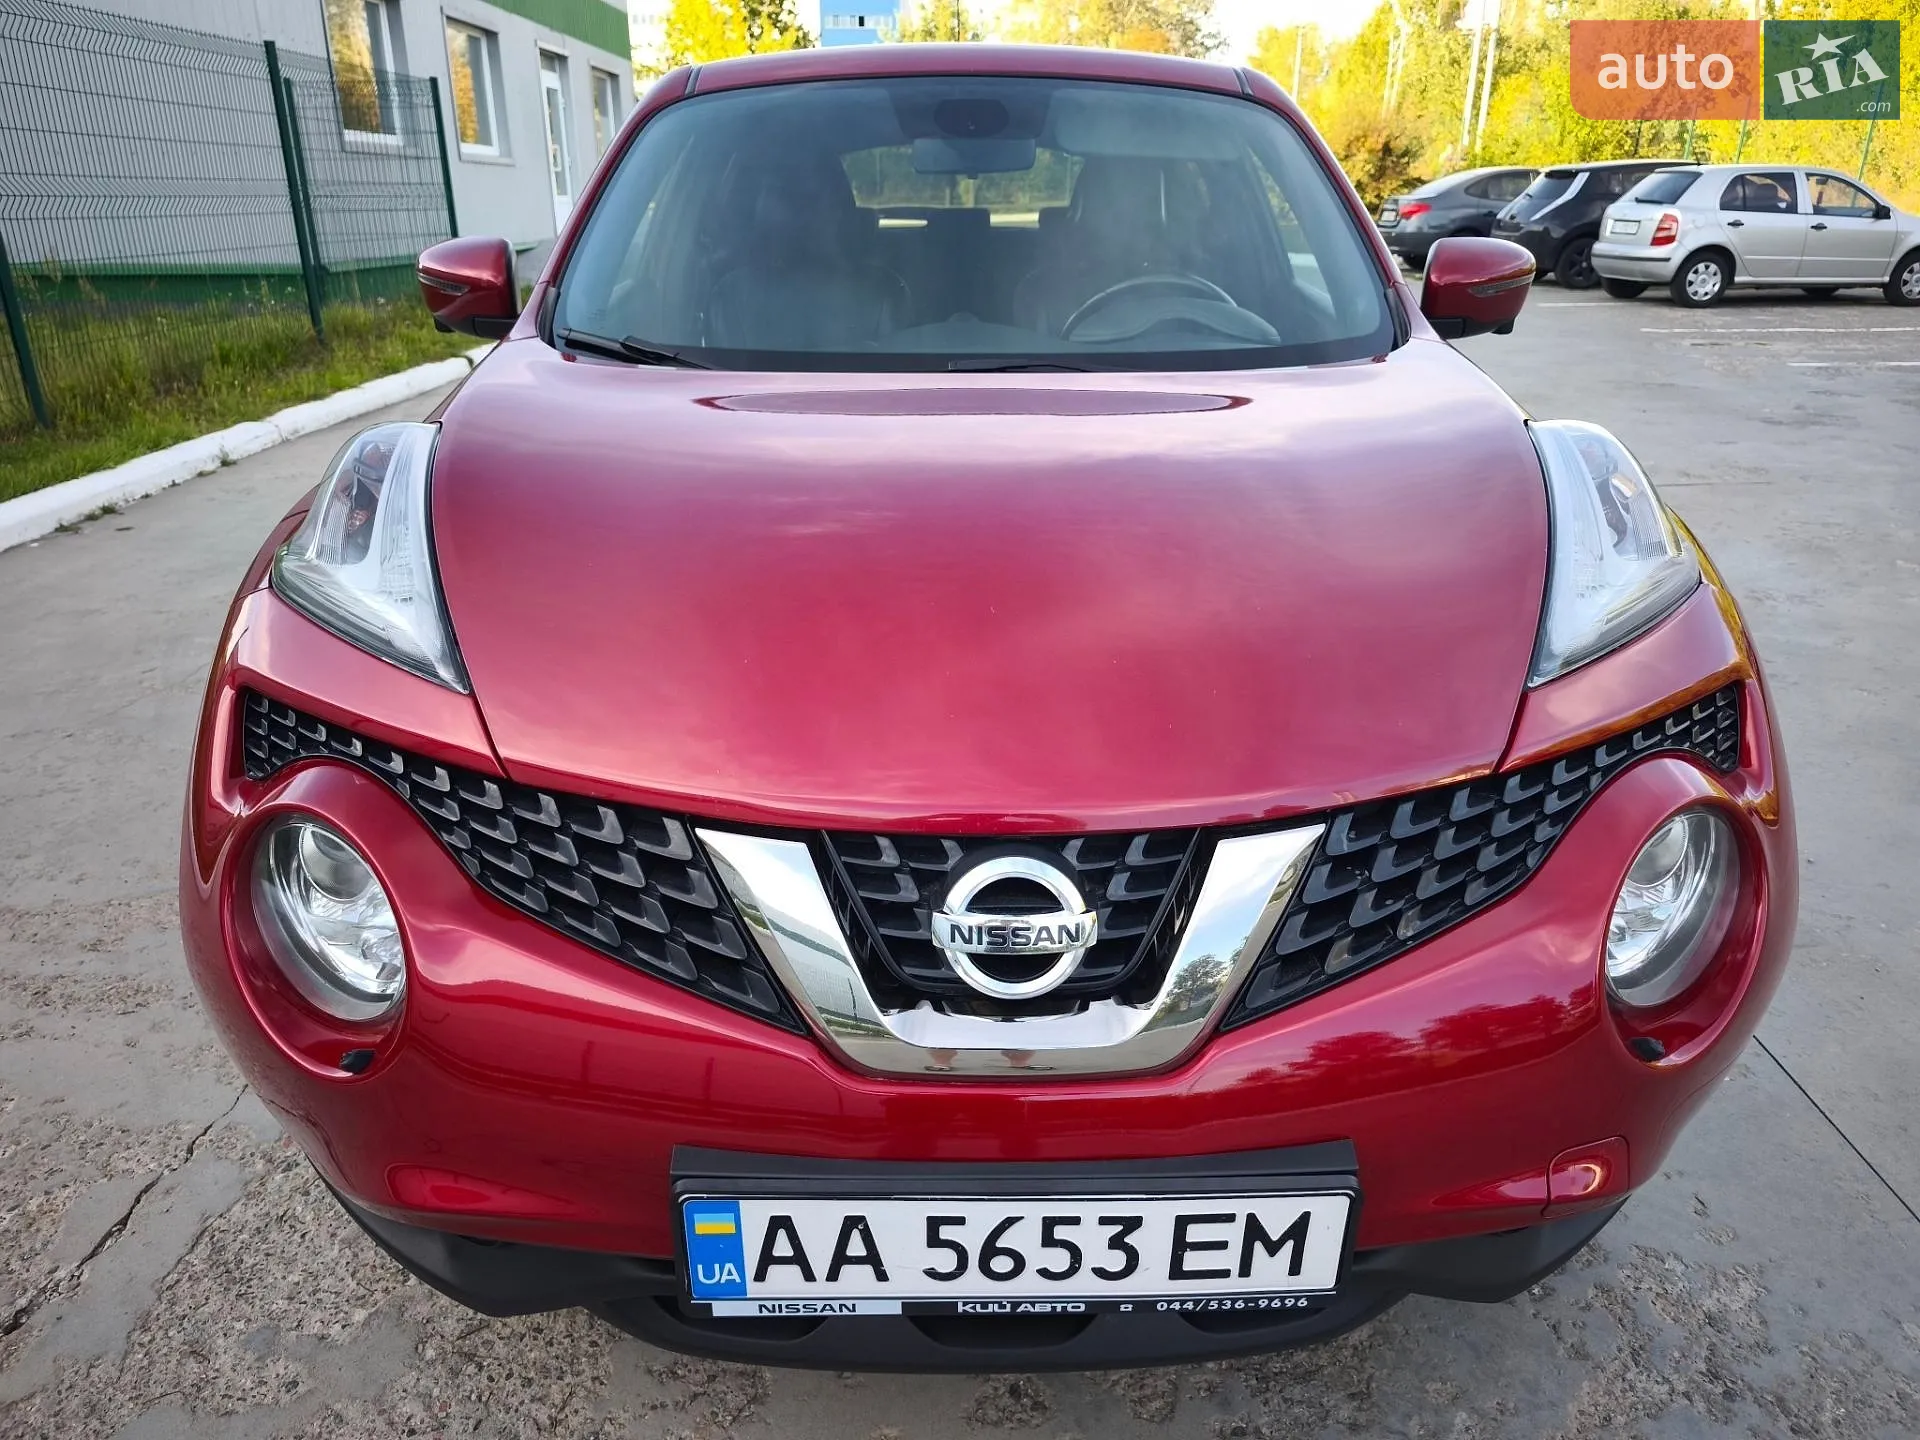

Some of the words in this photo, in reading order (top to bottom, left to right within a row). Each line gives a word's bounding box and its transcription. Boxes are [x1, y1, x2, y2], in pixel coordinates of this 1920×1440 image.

[949, 922, 1083, 947] NISSAN
[752, 1213, 890, 1283] AA
[922, 1213, 1144, 1283] 5653
[1167, 1210, 1312, 1281] EM
[697, 1262, 742, 1285] UA
[758, 1303, 857, 1314] NISSAN
[1156, 1297, 1309, 1312] 044/536-9696
